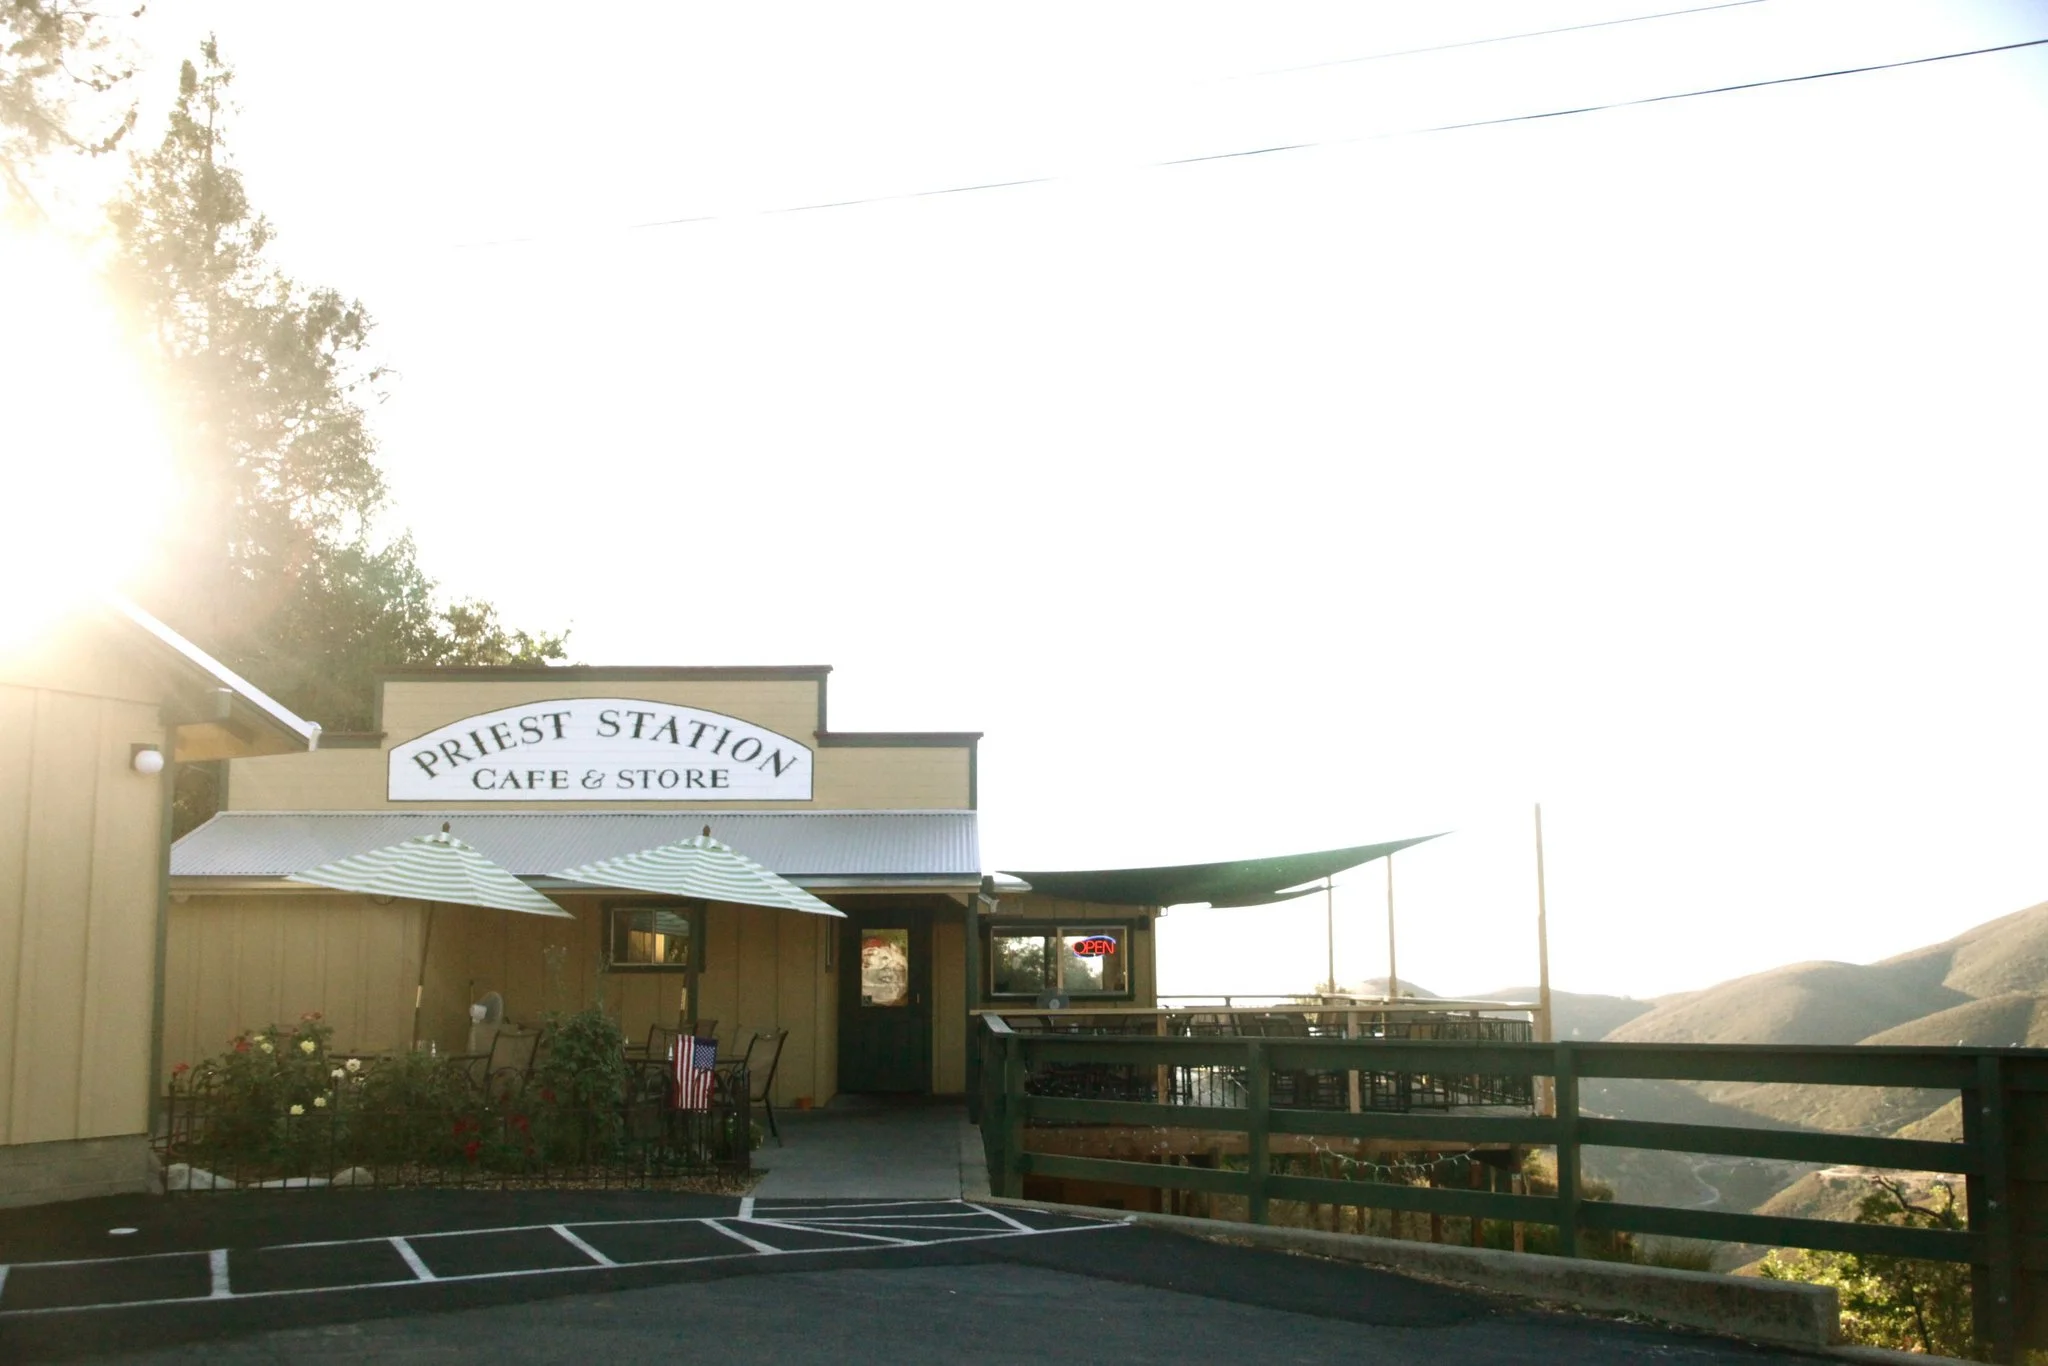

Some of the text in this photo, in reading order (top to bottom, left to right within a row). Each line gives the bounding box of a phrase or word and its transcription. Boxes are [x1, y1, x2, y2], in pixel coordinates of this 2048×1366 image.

[412, 710, 799, 780] PRIEST STATION
[472, 768, 730, 790] CAFE & STORE
[1073, 940, 1114, 955] OPEN
